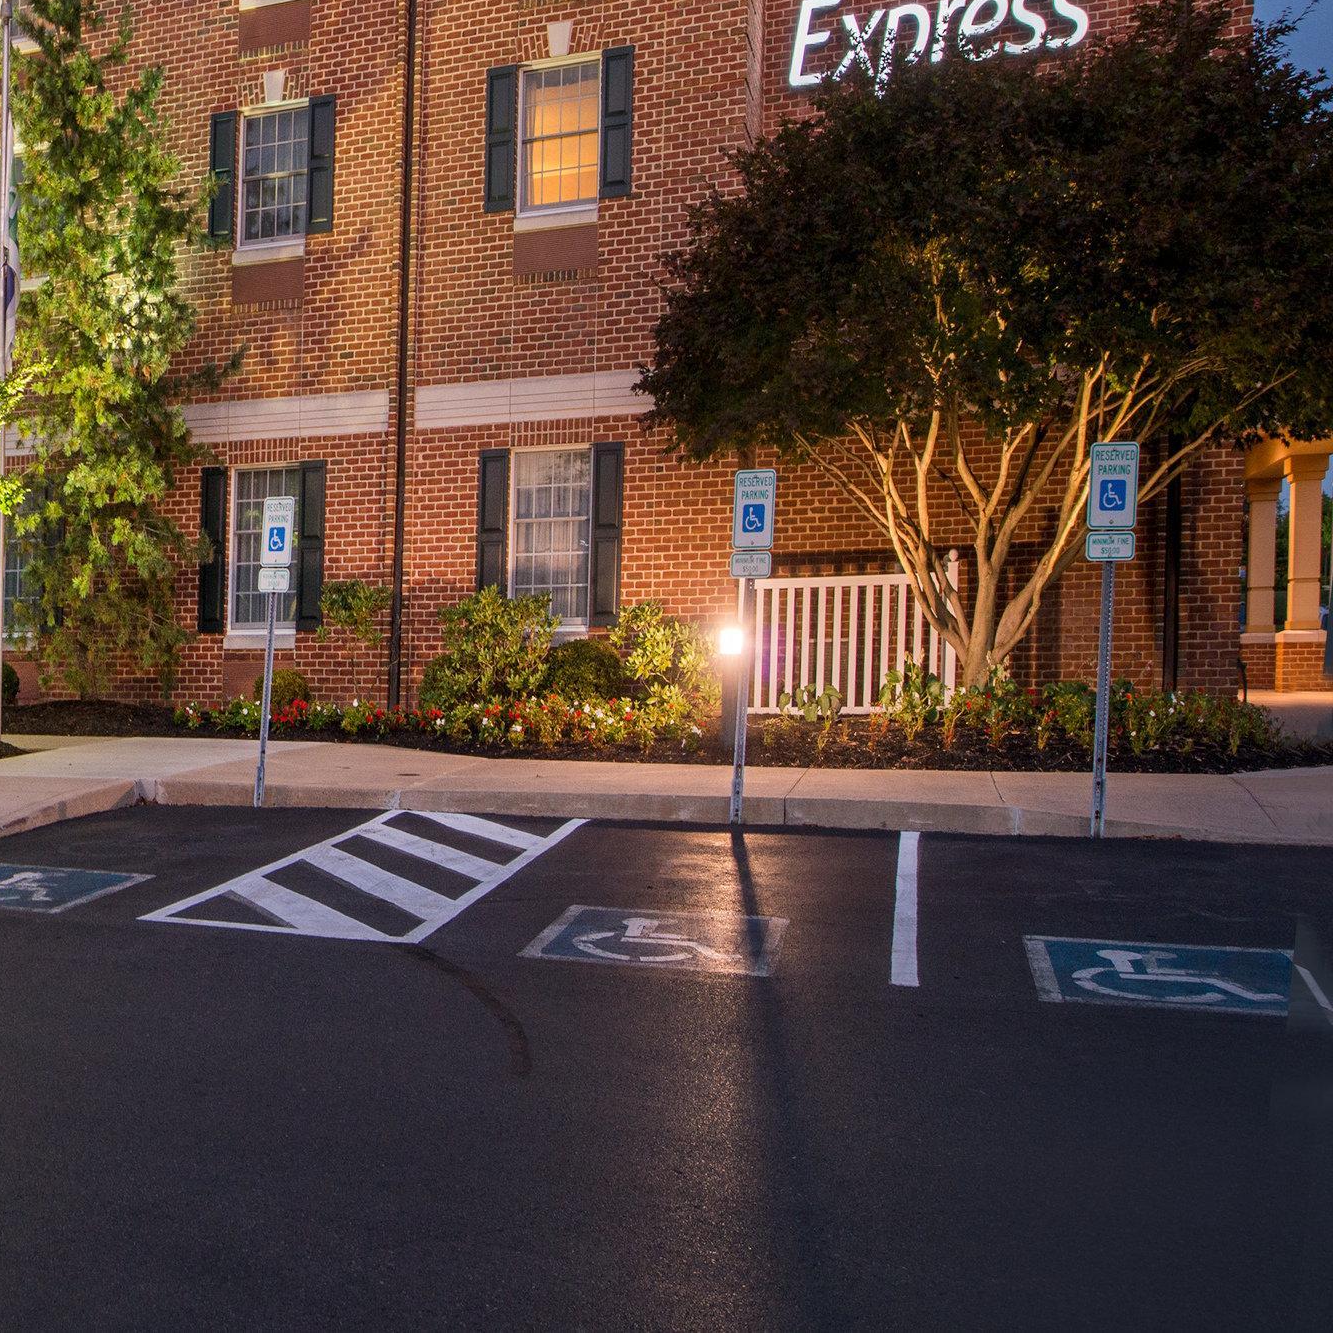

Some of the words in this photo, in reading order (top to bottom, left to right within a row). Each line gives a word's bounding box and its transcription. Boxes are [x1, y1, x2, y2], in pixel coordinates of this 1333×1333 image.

[1095, 449, 1136, 462] RESERVED
[1097, 463, 1131, 476] PARKING
[738, 476, 773, 488] RESERVED
[741, 489, 769, 500] PARKING
[1117, 536, 1130, 545] FINE
